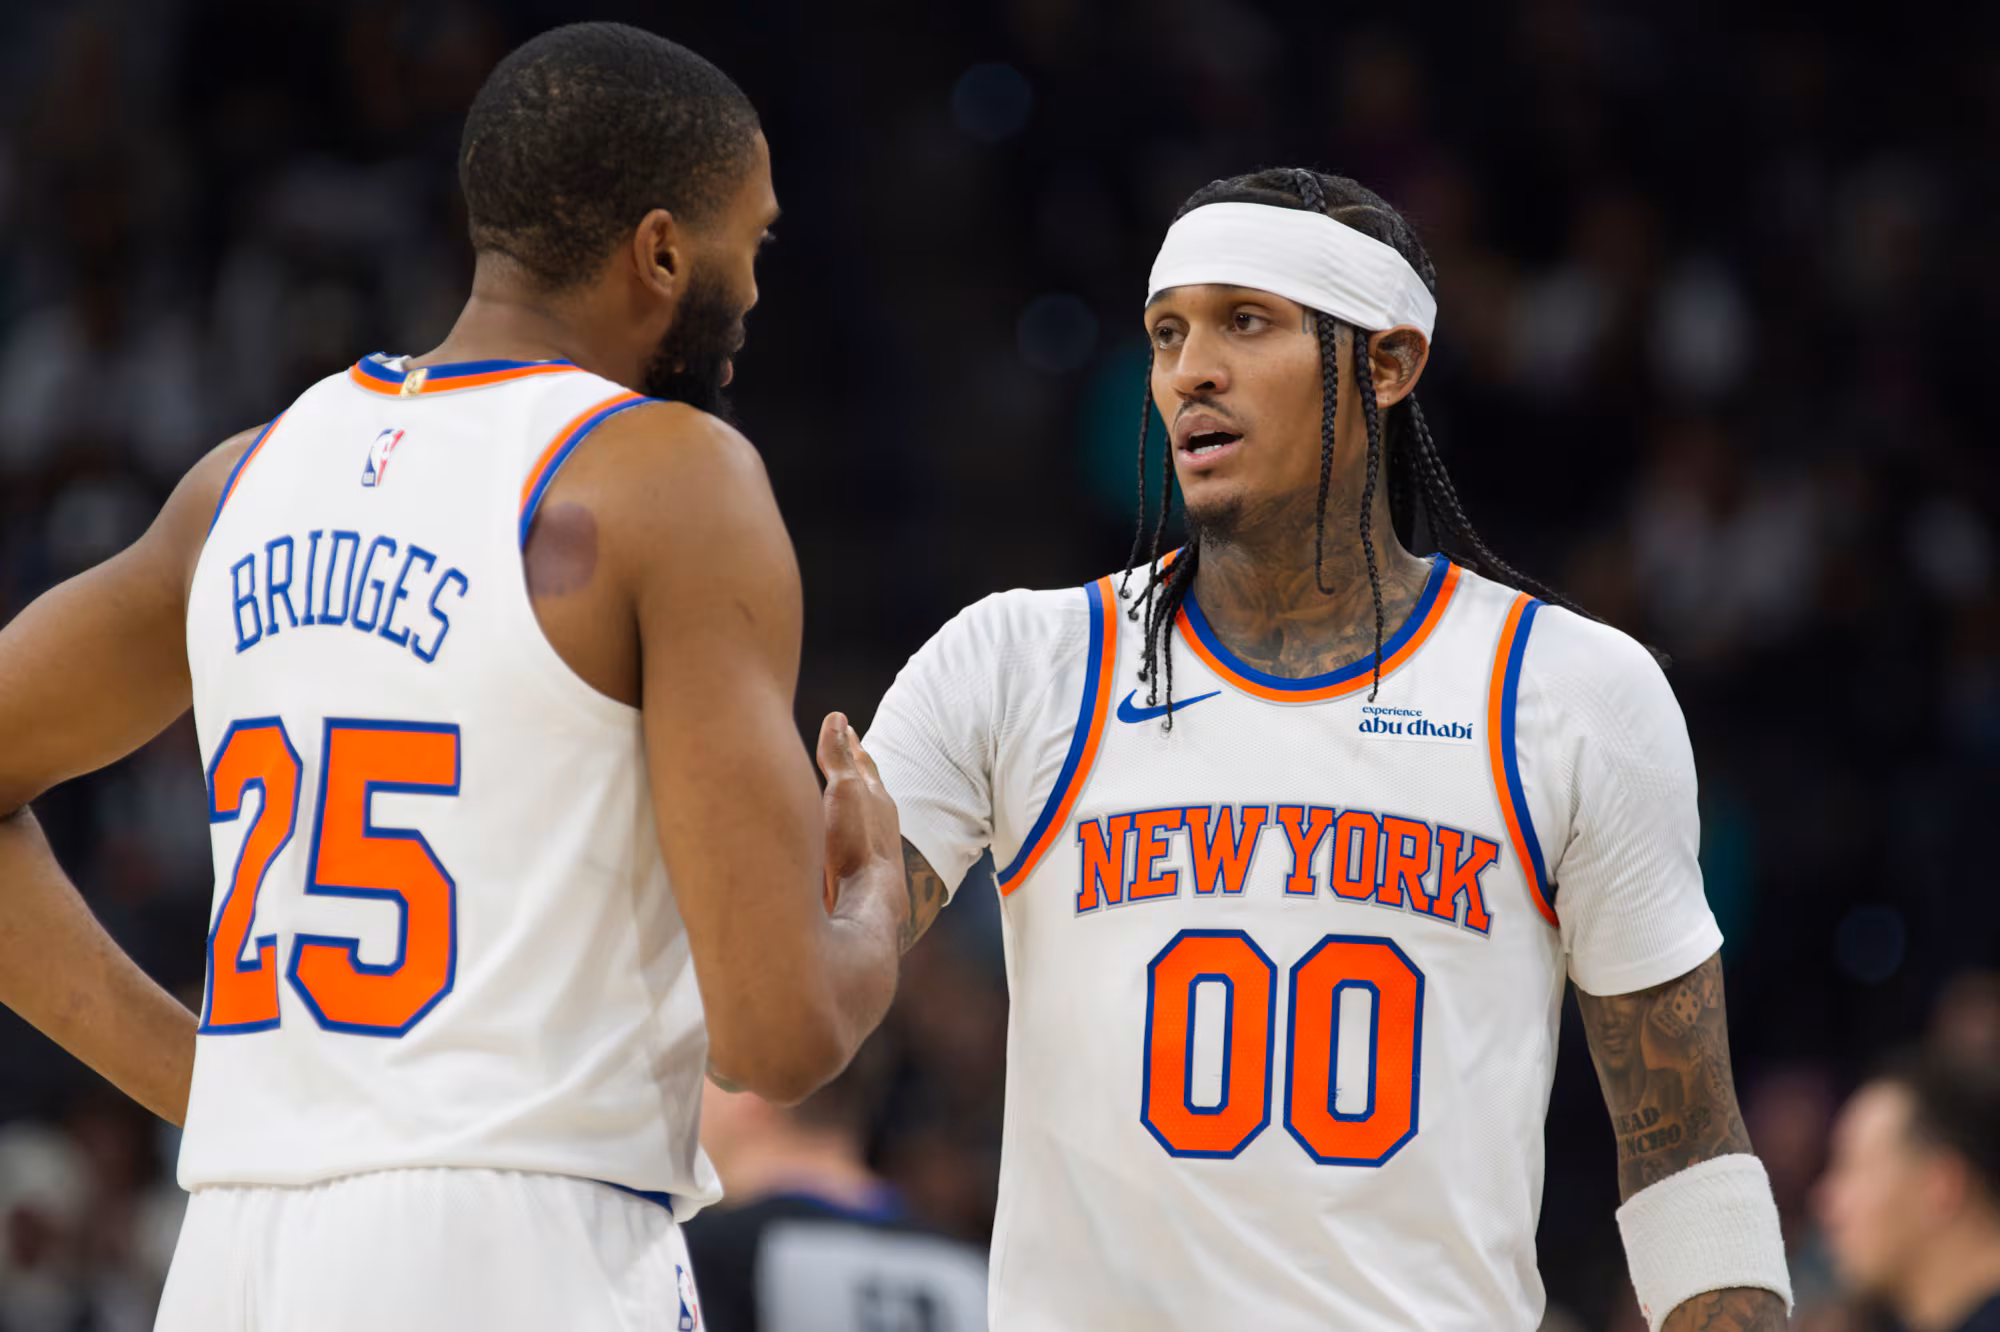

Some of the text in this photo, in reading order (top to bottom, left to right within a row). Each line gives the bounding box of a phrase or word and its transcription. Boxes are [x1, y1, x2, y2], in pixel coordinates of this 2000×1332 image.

[230, 529, 469, 663] BRIDGES
[1358, 716, 1402, 735] abu
[1361, 706, 1423, 717] experience
[197, 715, 461, 1038] 25
[1075, 802, 1500, 937] NEW YORK
[1140, 929, 1425, 1168] 00
